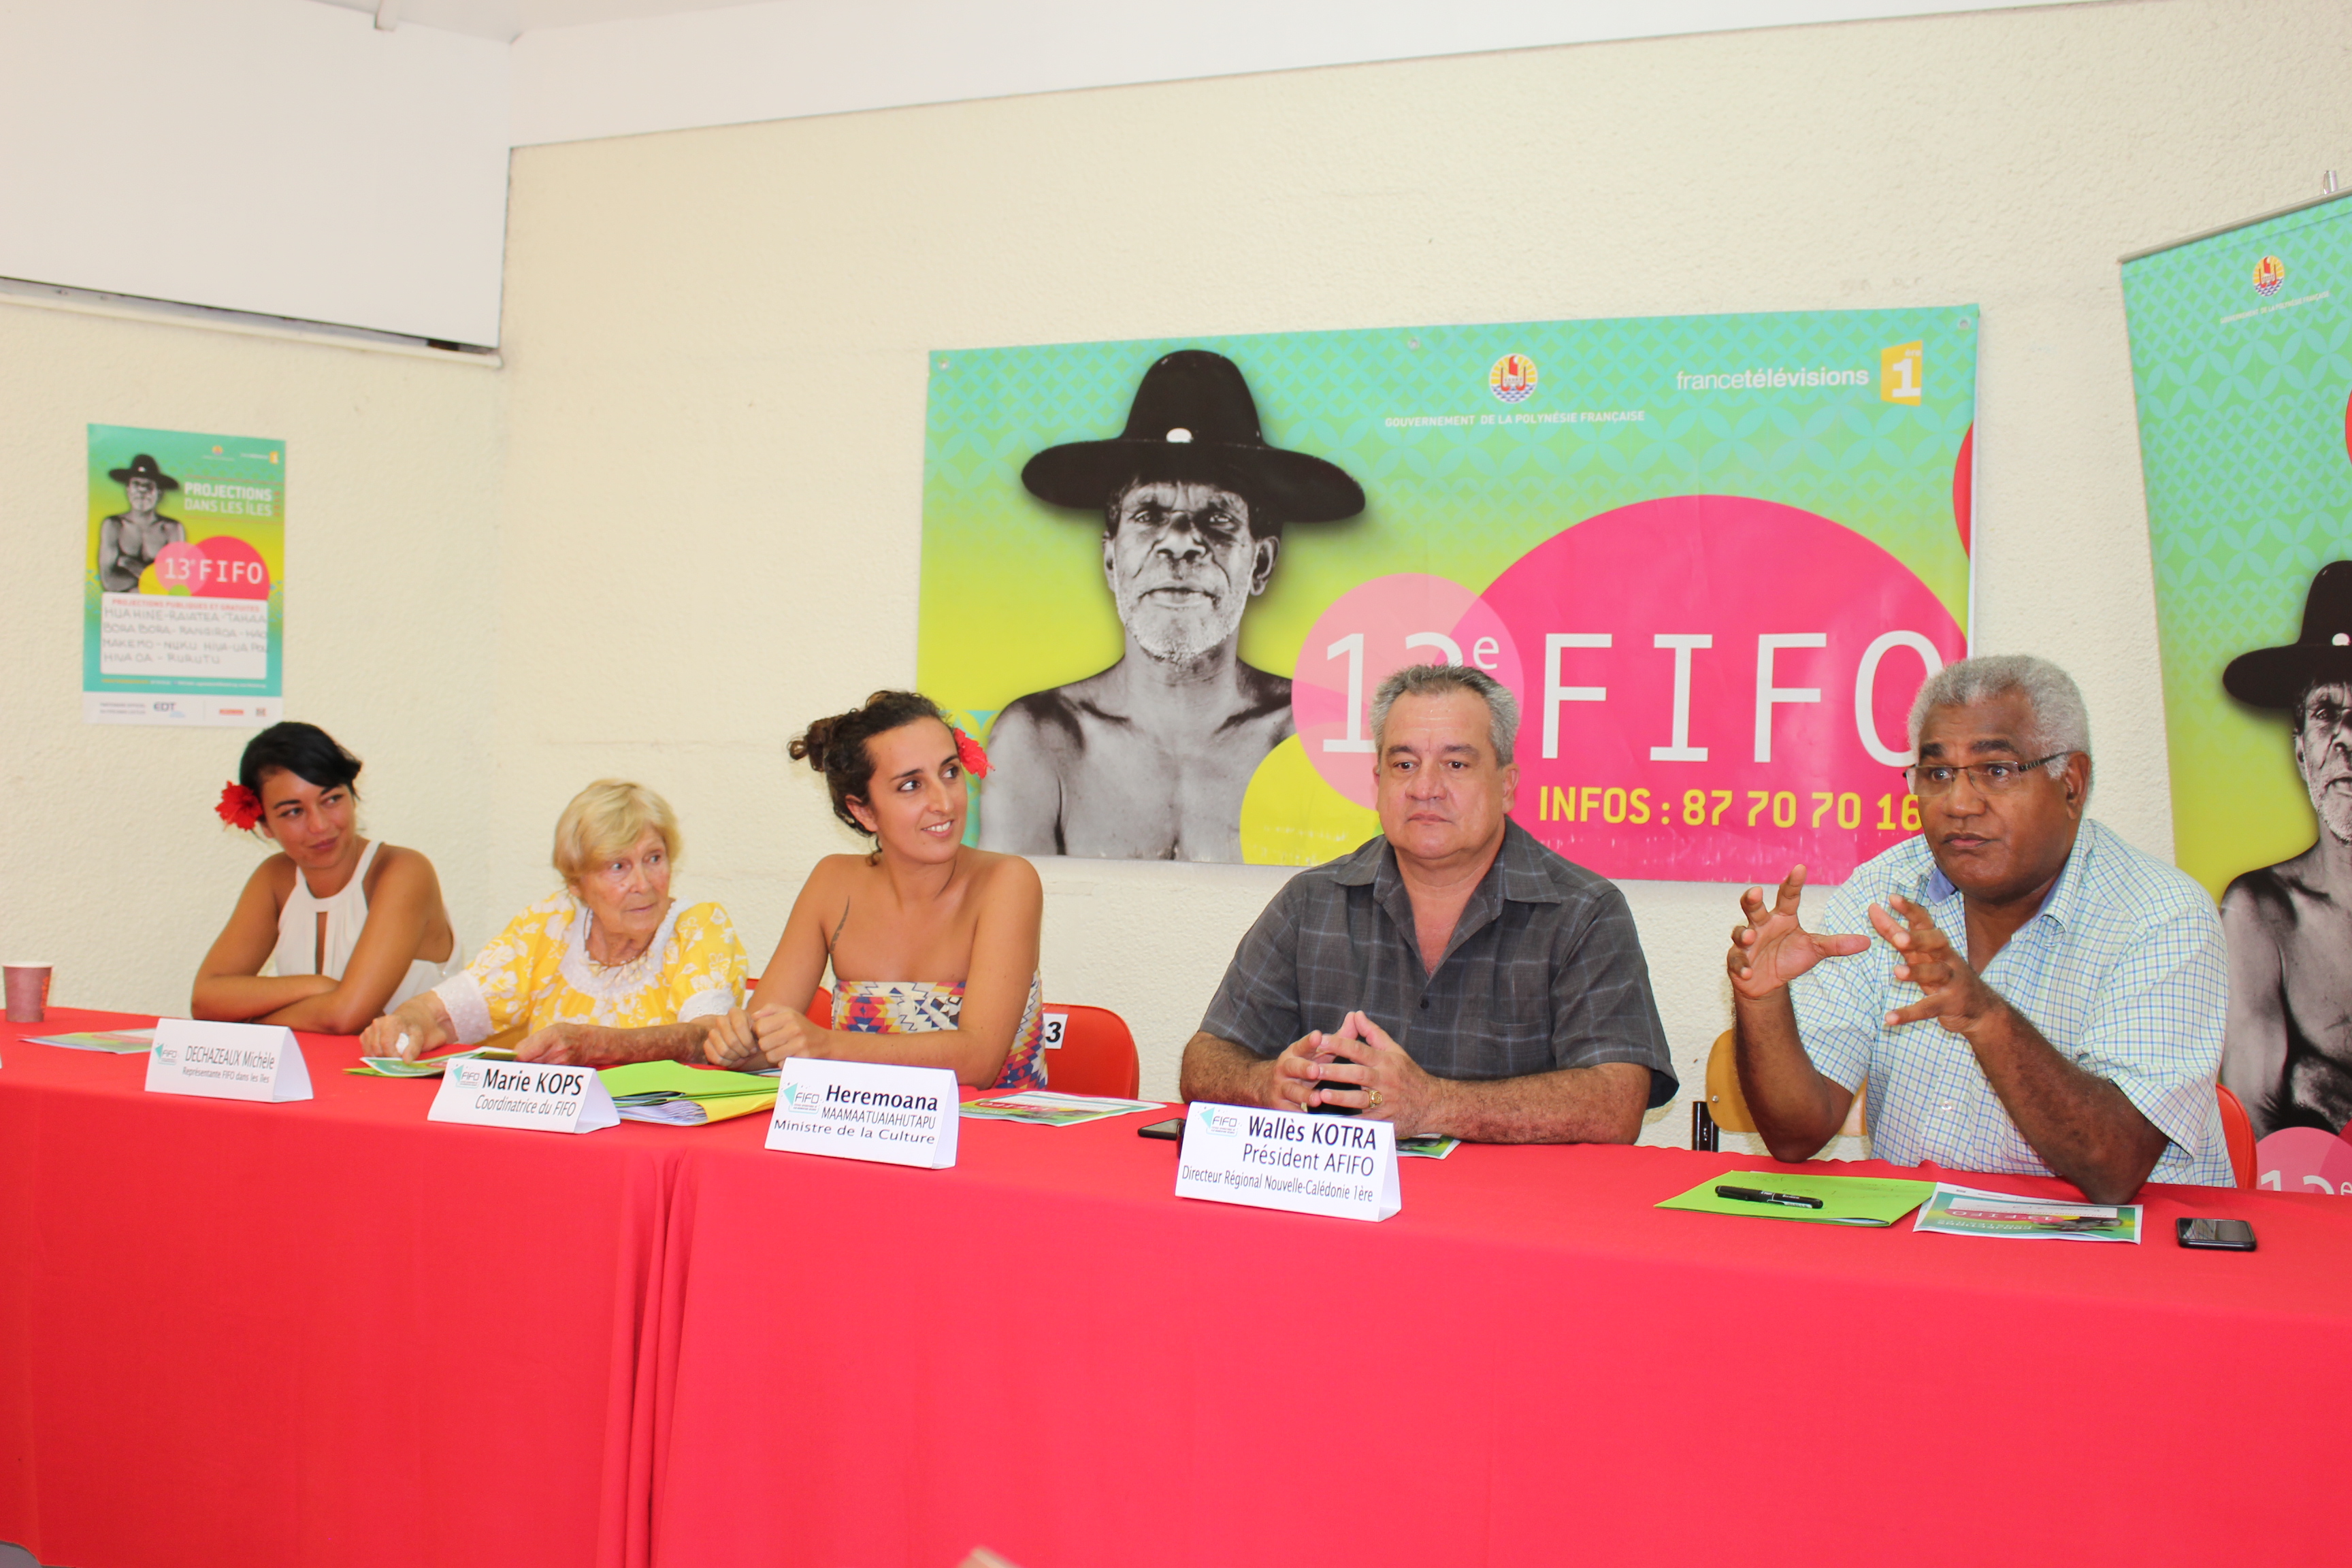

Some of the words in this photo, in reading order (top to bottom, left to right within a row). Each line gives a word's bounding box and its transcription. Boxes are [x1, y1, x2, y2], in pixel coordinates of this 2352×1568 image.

[1676, 367, 1869, 390] francetélévisions
[1386, 415, 1475, 427] GOUVERNEMENT
[1480, 414, 1495, 425] DE
[1499, 414, 1512, 425] LA
[1516, 411, 1578, 424] POLYNÉSIE
[1580, 410, 1645, 425] FRANÇAISE
[184, 481, 272, 502] PROJECTIONS
[184, 497, 218, 513] DANS
[220, 501, 243, 515] LES
[246, 500, 272, 517] ÎLES
[199, 559, 263, 585] FIFO
[1542, 630, 1944, 767] FIFO
[1539, 786, 1650, 824] INFOS
[1682, 789, 1732, 826] 87
[1747, 790, 1797, 829] 70
[1812, 791, 1862, 830] 70
[1876, 793, 1923, 832] 16
[1045, 1022, 1061, 1043] 3
[185, 1045, 242, 1066] DECHAZEAUX
[242, 1051, 275, 1070] Michèle
[182, 1066, 220, 1078] Représentante
[221, 1070, 235, 1080] FIFO
[235, 1071, 248, 1081] dans
[461, 1071, 480, 1081] FIFO
[483, 1068, 530, 1092] Marie
[535, 1073, 584, 1096] KOPS
[475, 1094, 537, 1115] Coordinatrice
[538, 1099, 553, 1115] du
[553, 1101, 577, 1117] FIFO
[794, 1092, 819, 1104] FIFO
[826, 1084, 938, 1111] Heremoana
[821, 1106, 936, 1130] MAAMAATUAIAHUTAPU
[1212, 1115, 1237, 1128] FIFO
[774, 1119, 832, 1134] Ministre
[837, 1125, 855, 1137] de
[860, 1126, 872, 1139] la
[879, 1128, 935, 1144] Culture
[1248, 1115, 1305, 1143] Wallès
[1311, 1122, 1377, 1150] KOTRA
[1243, 1143, 1319, 1171] Président
[1324, 1154, 1375, 1177] AFIFO
[1181, 1165, 1223, 1183] Directeur
[1224, 1170, 1262, 1189] Régional
[1264, 1175, 1350, 1200] Nouvelle-Calédonie
[1353, 1186, 1373, 1202] 1ère
